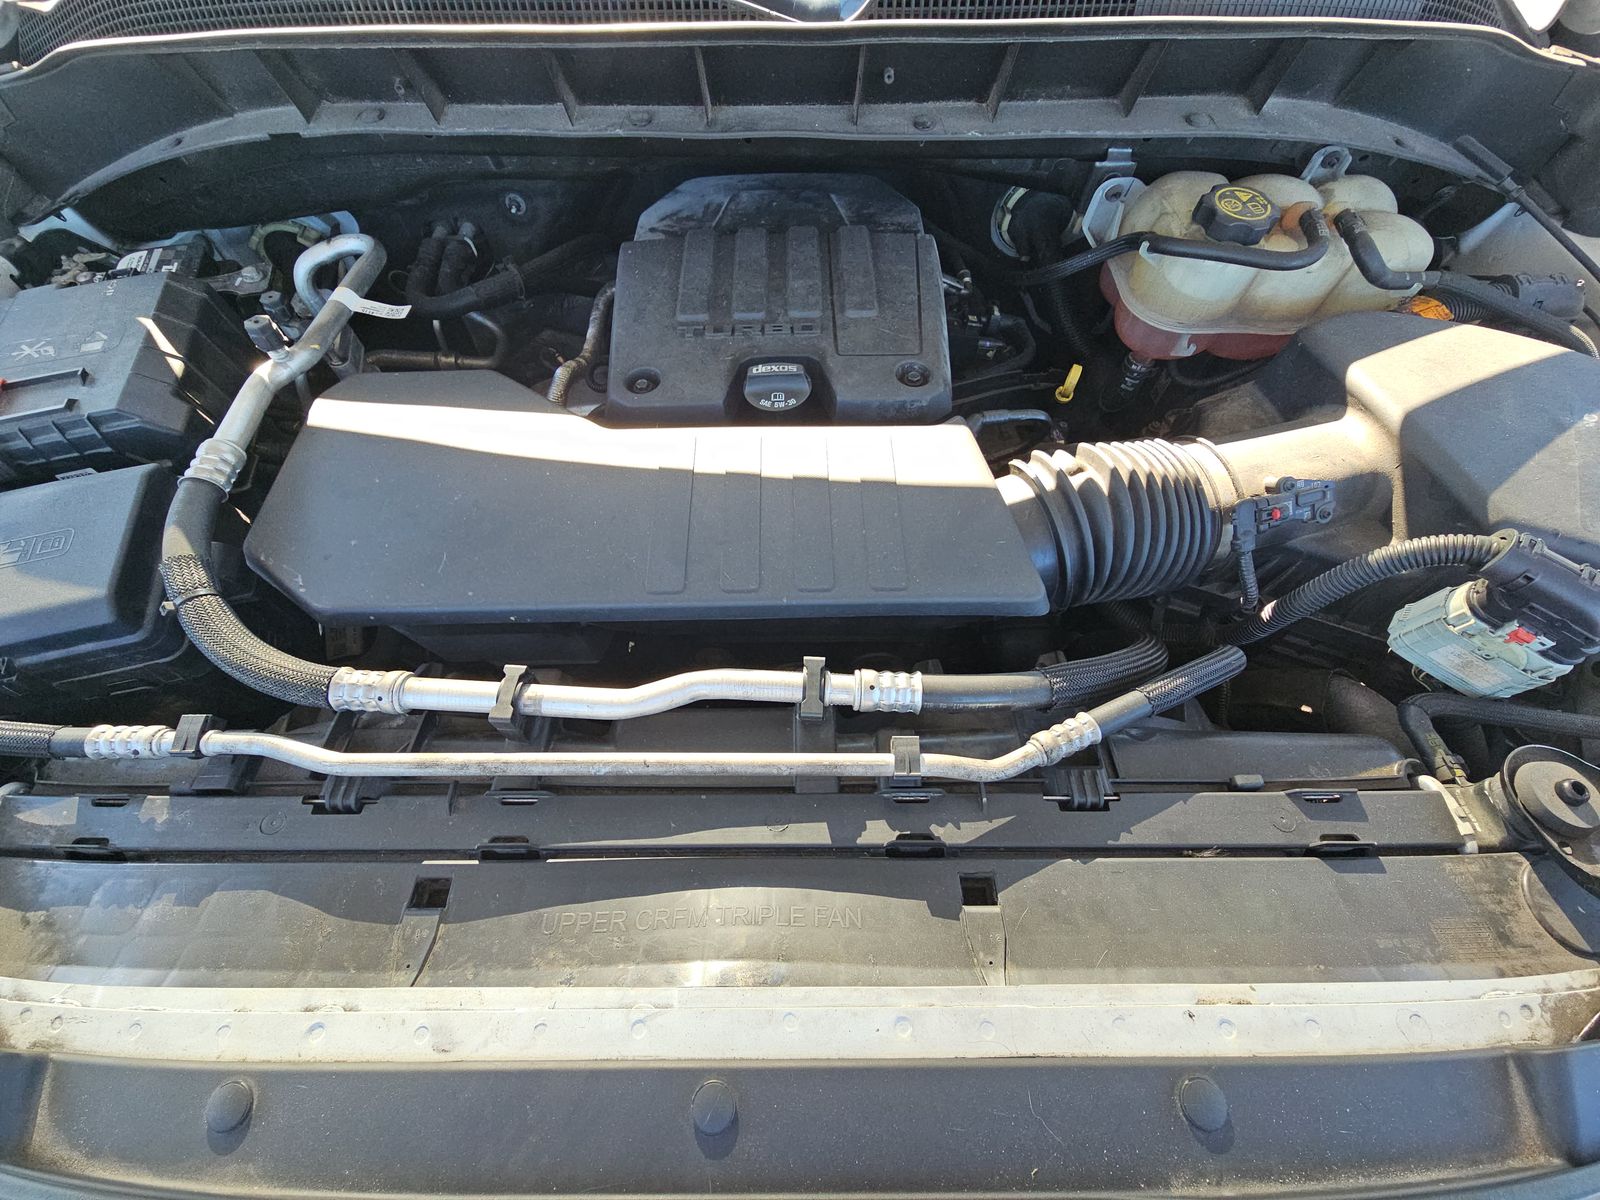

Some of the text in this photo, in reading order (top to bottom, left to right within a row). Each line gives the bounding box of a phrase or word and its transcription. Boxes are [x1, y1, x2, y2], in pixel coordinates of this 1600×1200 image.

[752, 364, 798, 374] dexos
[760, 398, 797, 408] SAE 5W-30
[541, 905, 862, 936] UPPER CRFM TRIPLE FAN
